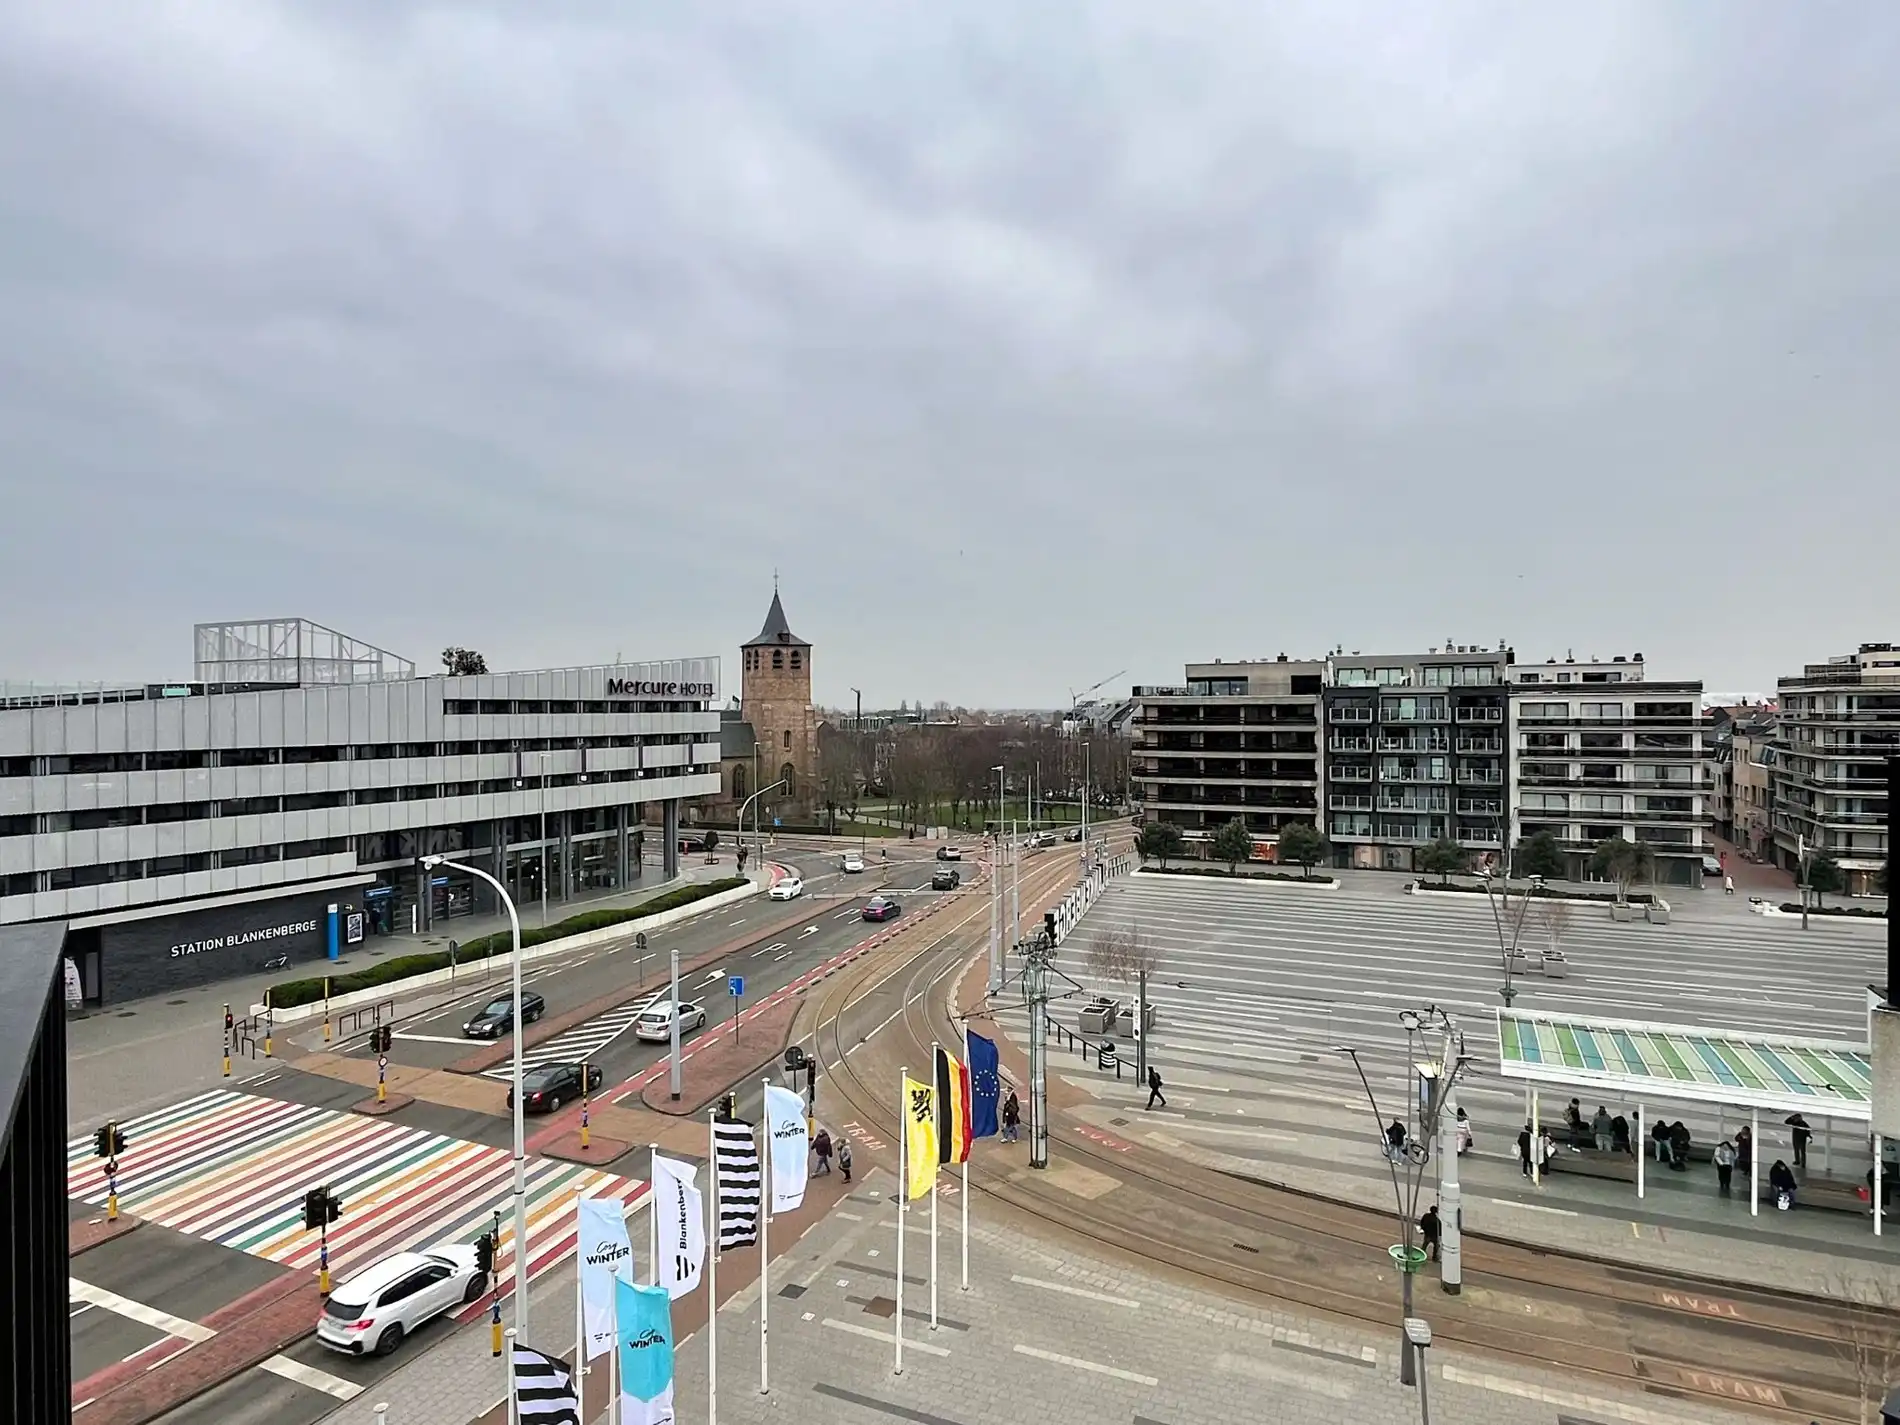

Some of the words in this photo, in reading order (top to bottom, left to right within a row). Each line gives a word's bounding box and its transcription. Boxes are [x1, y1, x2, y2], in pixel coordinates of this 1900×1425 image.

[608, 678, 677, 696] Mercure
[680, 682, 716, 697] HOTEL
[170, 938, 224, 958] STATION
[226, 920, 317, 947] BLANKENBERGE
[774, 1127, 805, 1139] WINTER
[843, 1121, 887, 1151] TRAM
[675, 1177, 688, 1250] Blankenber
[586, 1246, 630, 1265] WINTER
[1662, 1292, 1741, 1317] TRAM
[629, 1335, 666, 1349] WINTER
[1687, 1372, 1778, 1403] TRAM
